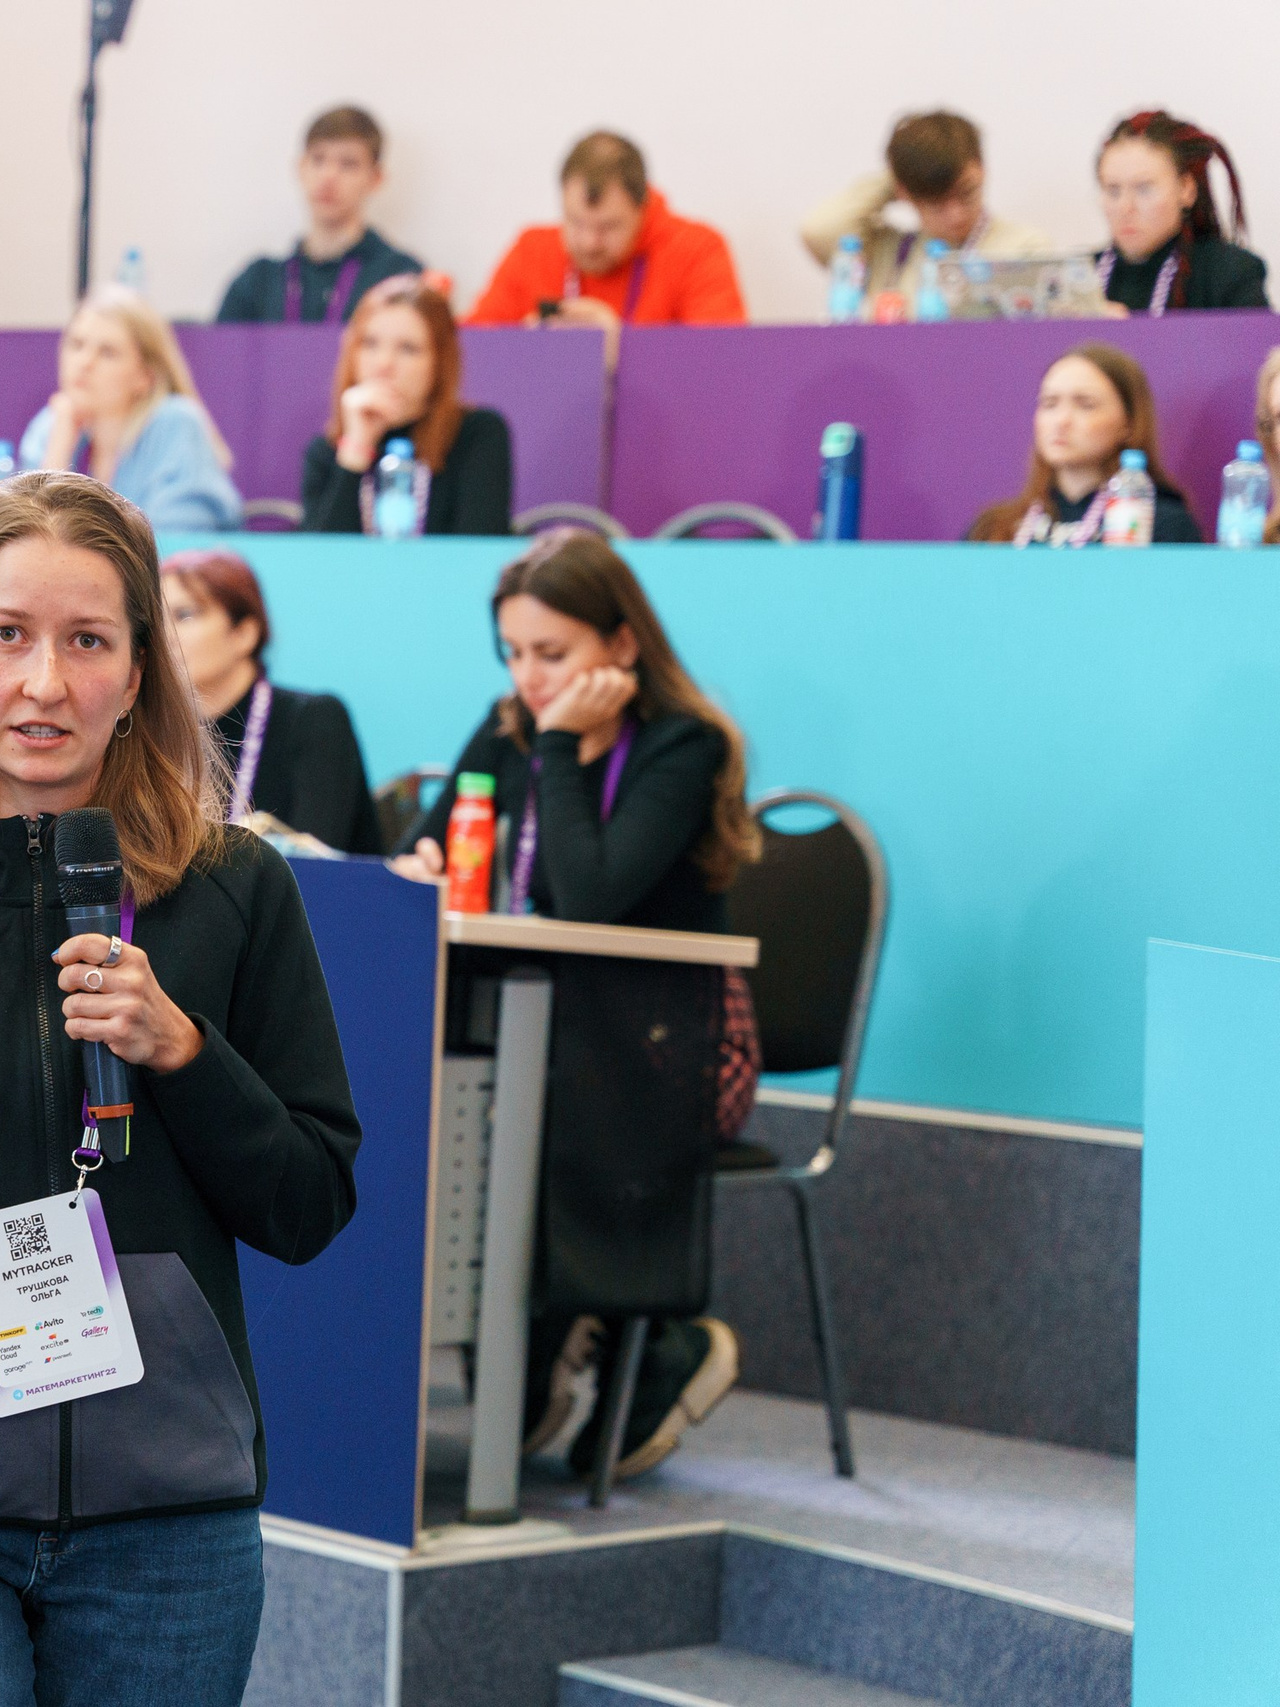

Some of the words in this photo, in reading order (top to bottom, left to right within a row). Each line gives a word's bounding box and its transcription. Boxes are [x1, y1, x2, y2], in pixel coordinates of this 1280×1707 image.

[2, 1254, 74, 1281] MYTRACKER
[17, 1275, 70, 1295] ТРУШКОВА
[30, 1288, 62, 1303] ОЛЬГА
[87, 1307, 101, 1316] tech
[43, 1318, 64, 1328] Avito
[81, 1326, 109, 1338] Gallery
[40, 1340, 64, 1351] excite
[0, 1352, 18, 1361] Cloud
[3, 1363, 27, 1376] garage
[25, 1367, 117, 1396] МАТЕМАРКЕТИНГ22
